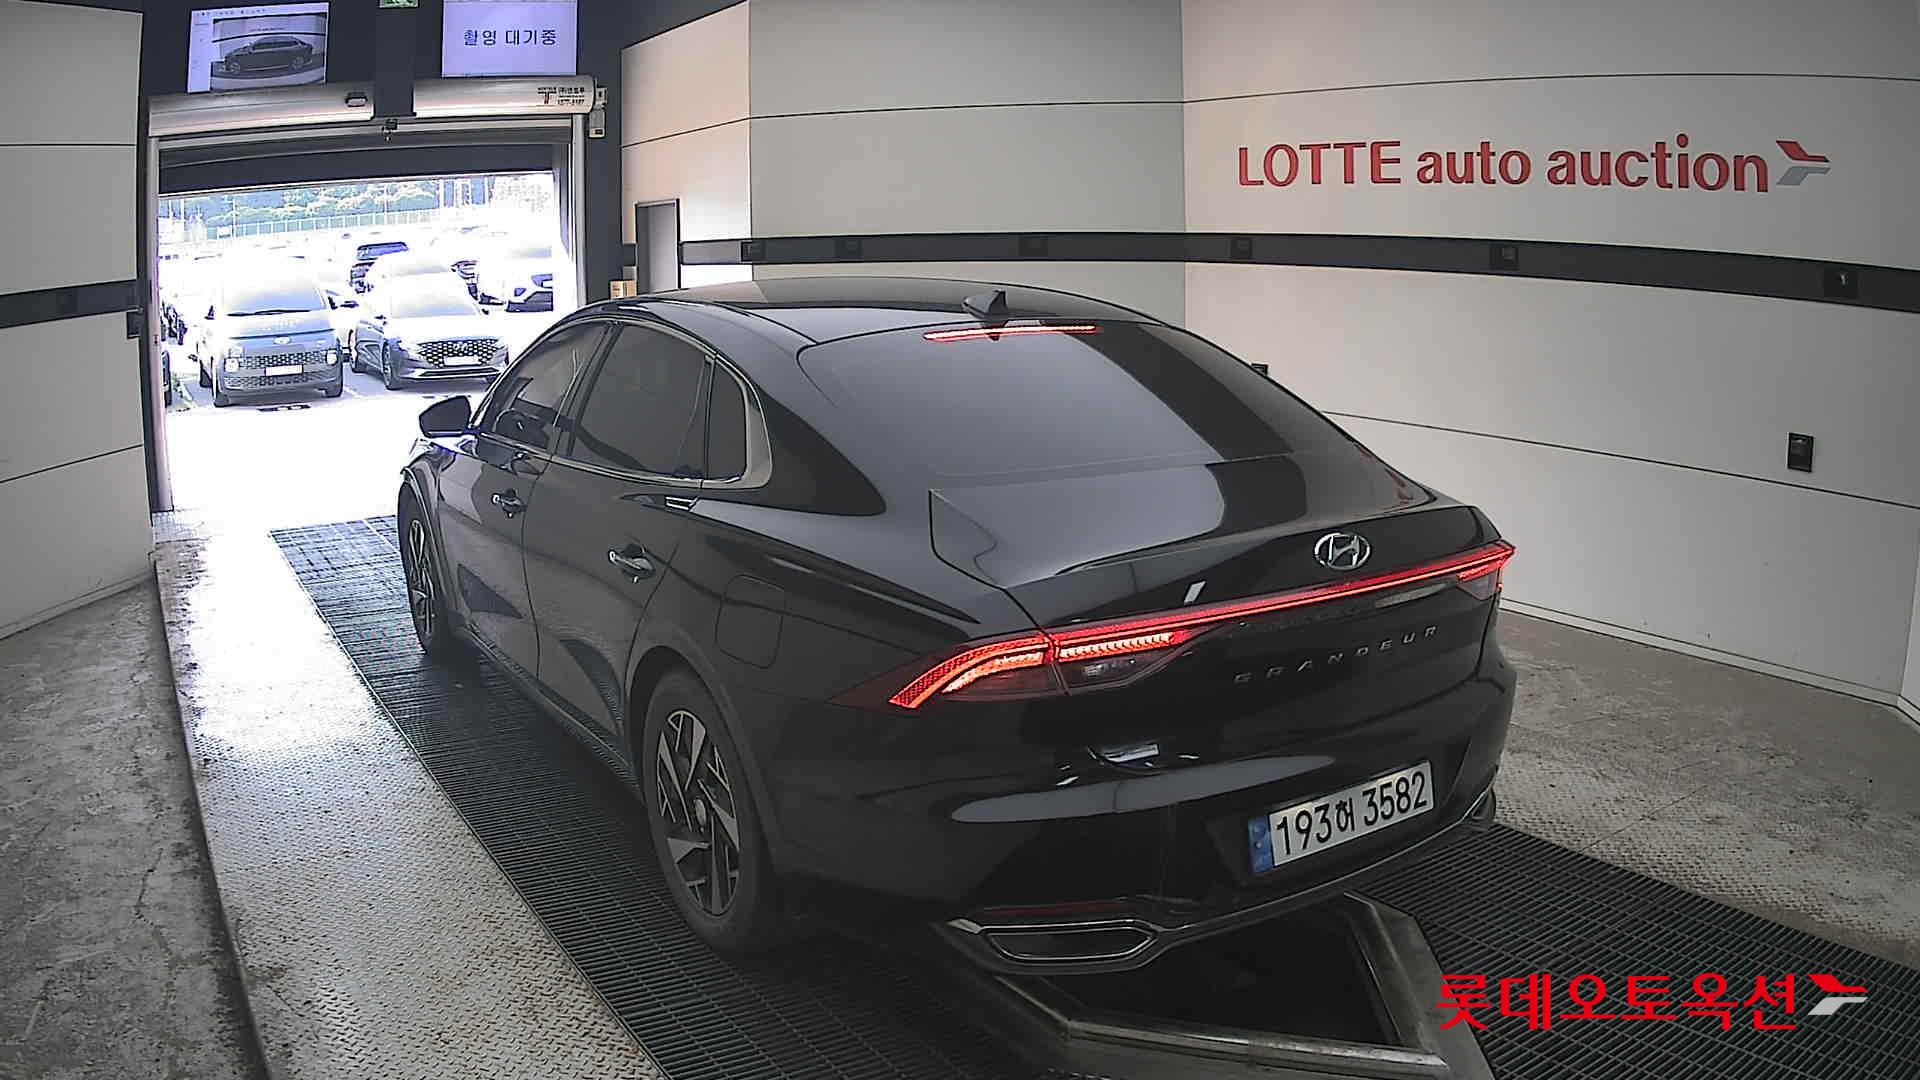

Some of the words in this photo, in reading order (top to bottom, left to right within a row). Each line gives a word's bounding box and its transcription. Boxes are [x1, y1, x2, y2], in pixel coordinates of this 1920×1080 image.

[504, 29, 557, 46] 대기중
[1239, 141, 1401, 187] LOTTE
[1416, 141, 1531, 187] auto
[1547, 133, 1768, 193] auction
[1234, 626, 1437, 684] GRANDEUR
[1276, 797, 1356, 856] 193허
[1362, 770, 1427, 826] 3582
